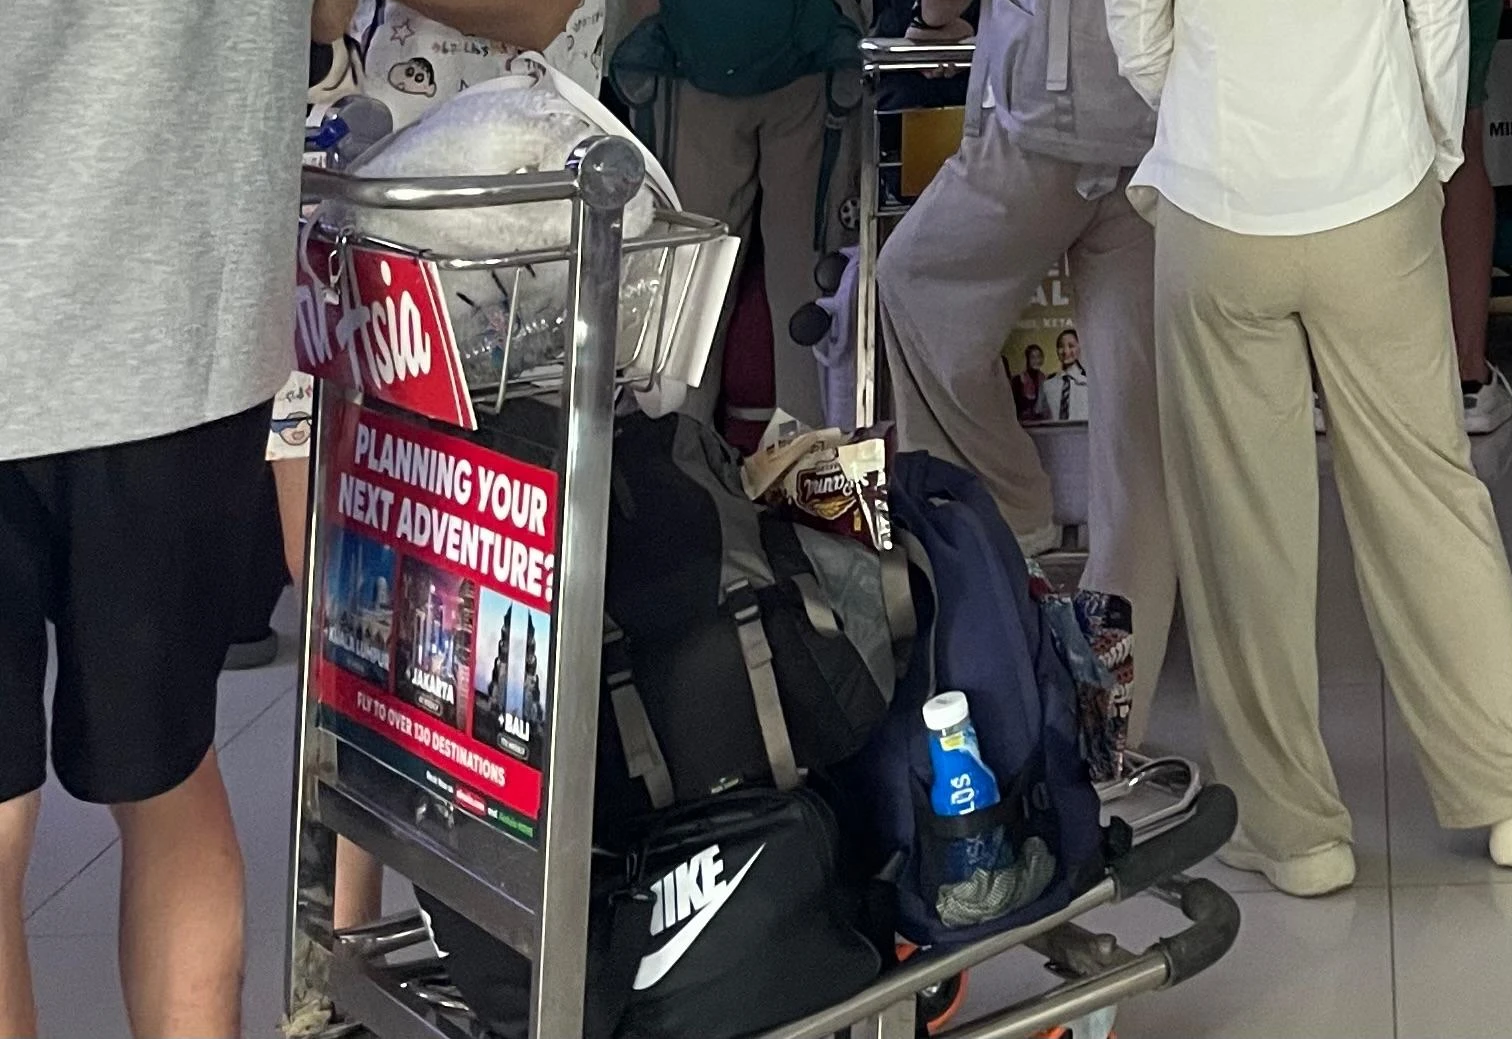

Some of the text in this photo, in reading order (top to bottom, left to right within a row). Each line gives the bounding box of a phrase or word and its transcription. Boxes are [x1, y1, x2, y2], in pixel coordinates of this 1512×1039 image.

[338, 472, 395, 532] NEXT
[355, 424, 548, 536] PLANNING YOUR
[411, 666, 455, 705] JAKARTA
[356, 690, 374, 713] FLY
[373, 699, 387, 722] TO
[387, 707, 413, 737] OVER
[413, 721, 431, 747] 130
[431, 730, 506, 788] DESTINATIONS
[504, 712, 530, 742] BALI
